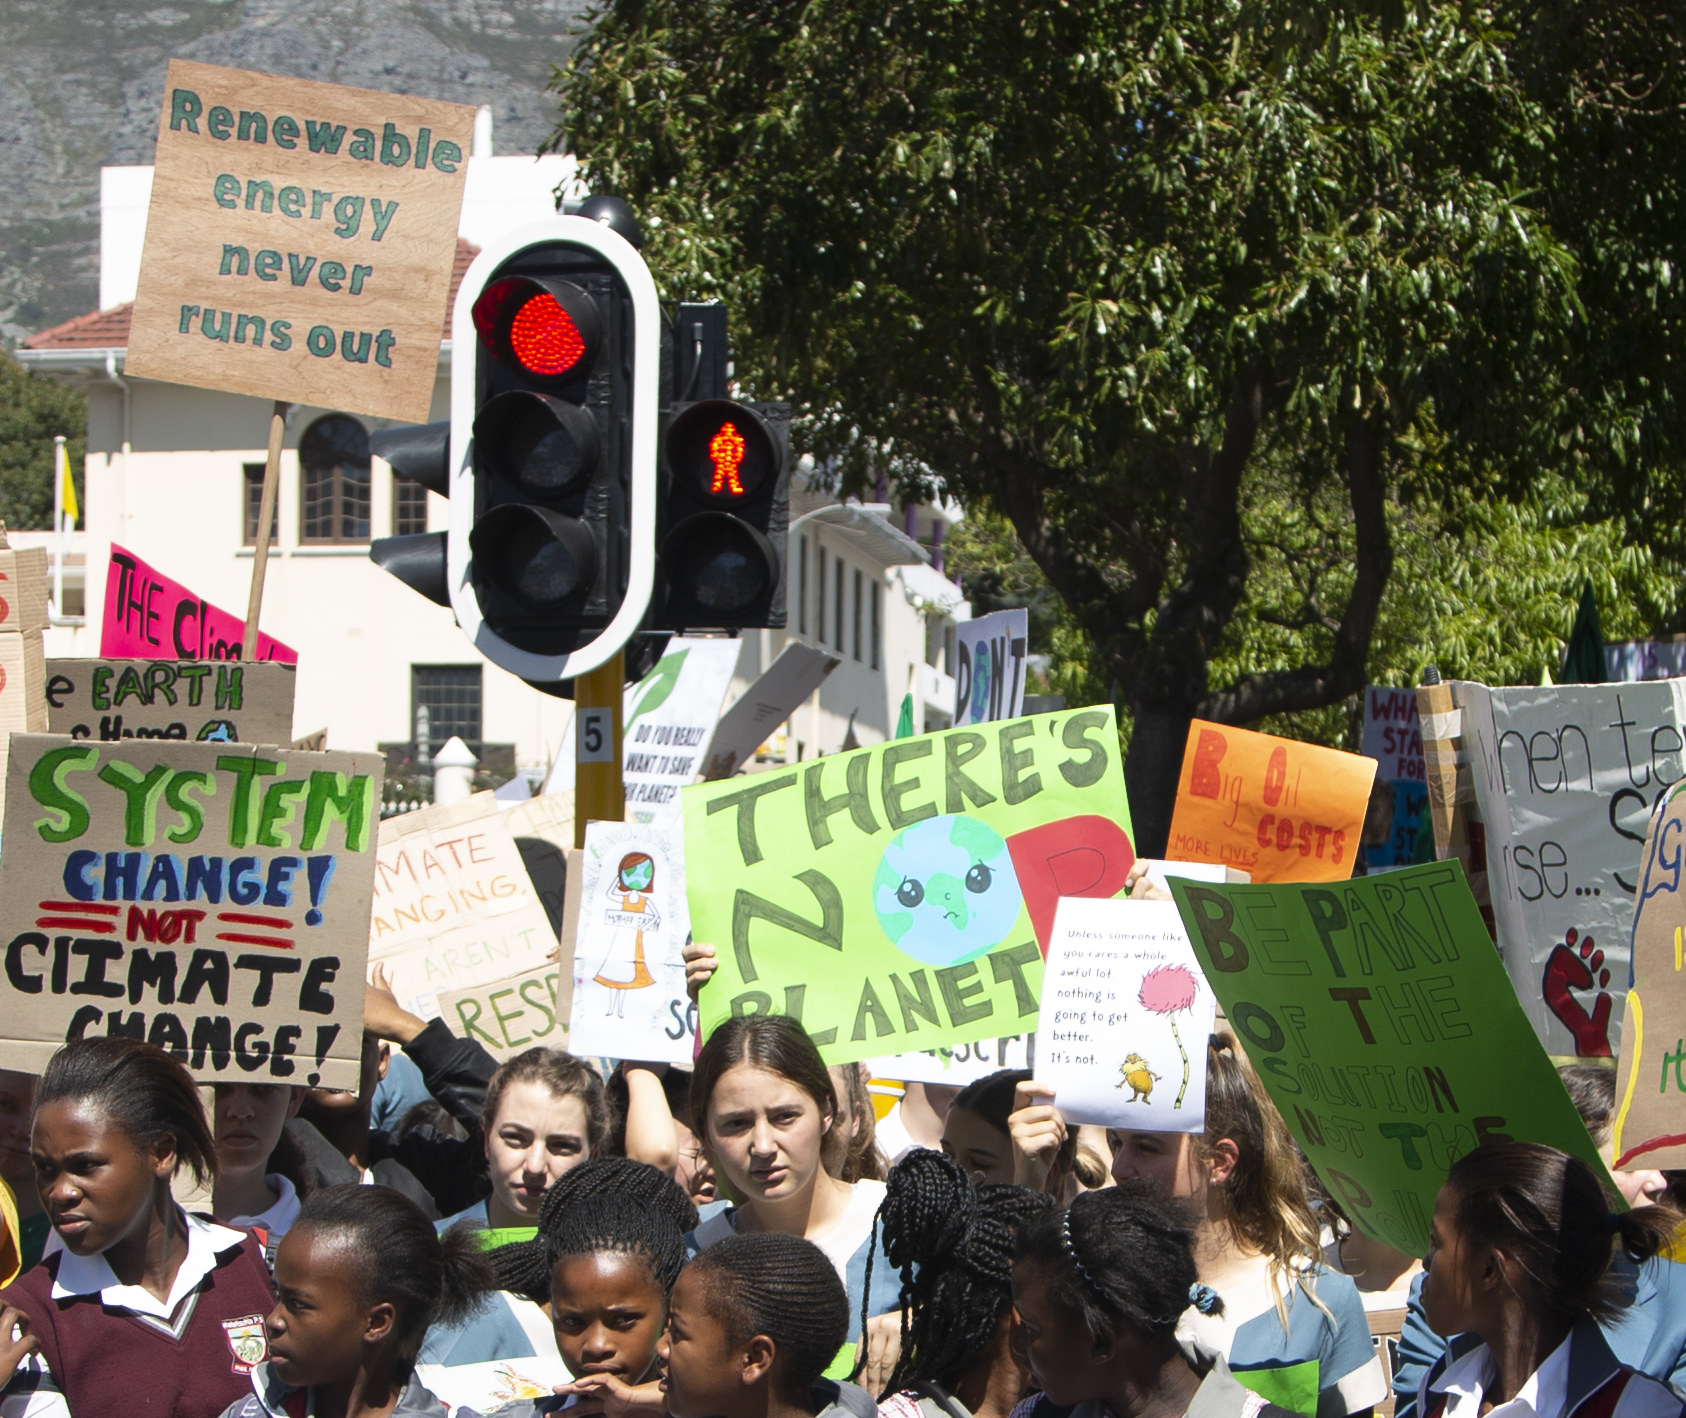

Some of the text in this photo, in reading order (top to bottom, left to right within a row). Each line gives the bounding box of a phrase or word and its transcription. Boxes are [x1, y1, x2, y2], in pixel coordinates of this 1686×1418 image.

[170, 88, 462, 173] Renewable
[213, 173, 399, 241] energy
[219, 244, 372, 295] never
[178, 304, 396, 368] runs out
[112, 553, 163, 646] THE
[92, 663, 243, 711] EARTH
[584, 715, 603, 753] 5
[635, 724, 706, 747] DO YOU REALLY
[626, 752, 695, 776] WANT TO SAVE
[706, 710, 1110, 867] THERE'S
[1189, 728, 1301, 829] Big Oil
[29, 747, 373, 852] SYSTEM
[637, 785, 677, 804] PLANET?
[1174, 833, 1259, 864] MORE LIVES
[1257, 813, 1346, 865] COSTS
[64, 850, 337, 926] CHANGE!
[126, 903, 207, 945] NOT
[1068, 930, 1184, 942] Unless someone like
[1183, 868, 1461, 978] BE PART
[5, 933, 341, 1015] CLIMATE
[1060, 968, 1112, 979] awful lot
[1063, 950, 1084, 960] you
[1088, 951, 1119, 960] cares
[1134, 951, 1167, 961] whole
[1054, 1010, 1128, 1026] going to get
[1057, 987, 1116, 1003] nothing is
[1232, 975, 1473, 1059] OF THE
[1051, 1051, 1098, 1065] It's not.
[1053, 1030, 1093, 1042] better.
[1263, 1056, 1461, 1115] SOLUTION
[1293, 1103, 1366, 1159] NOT
